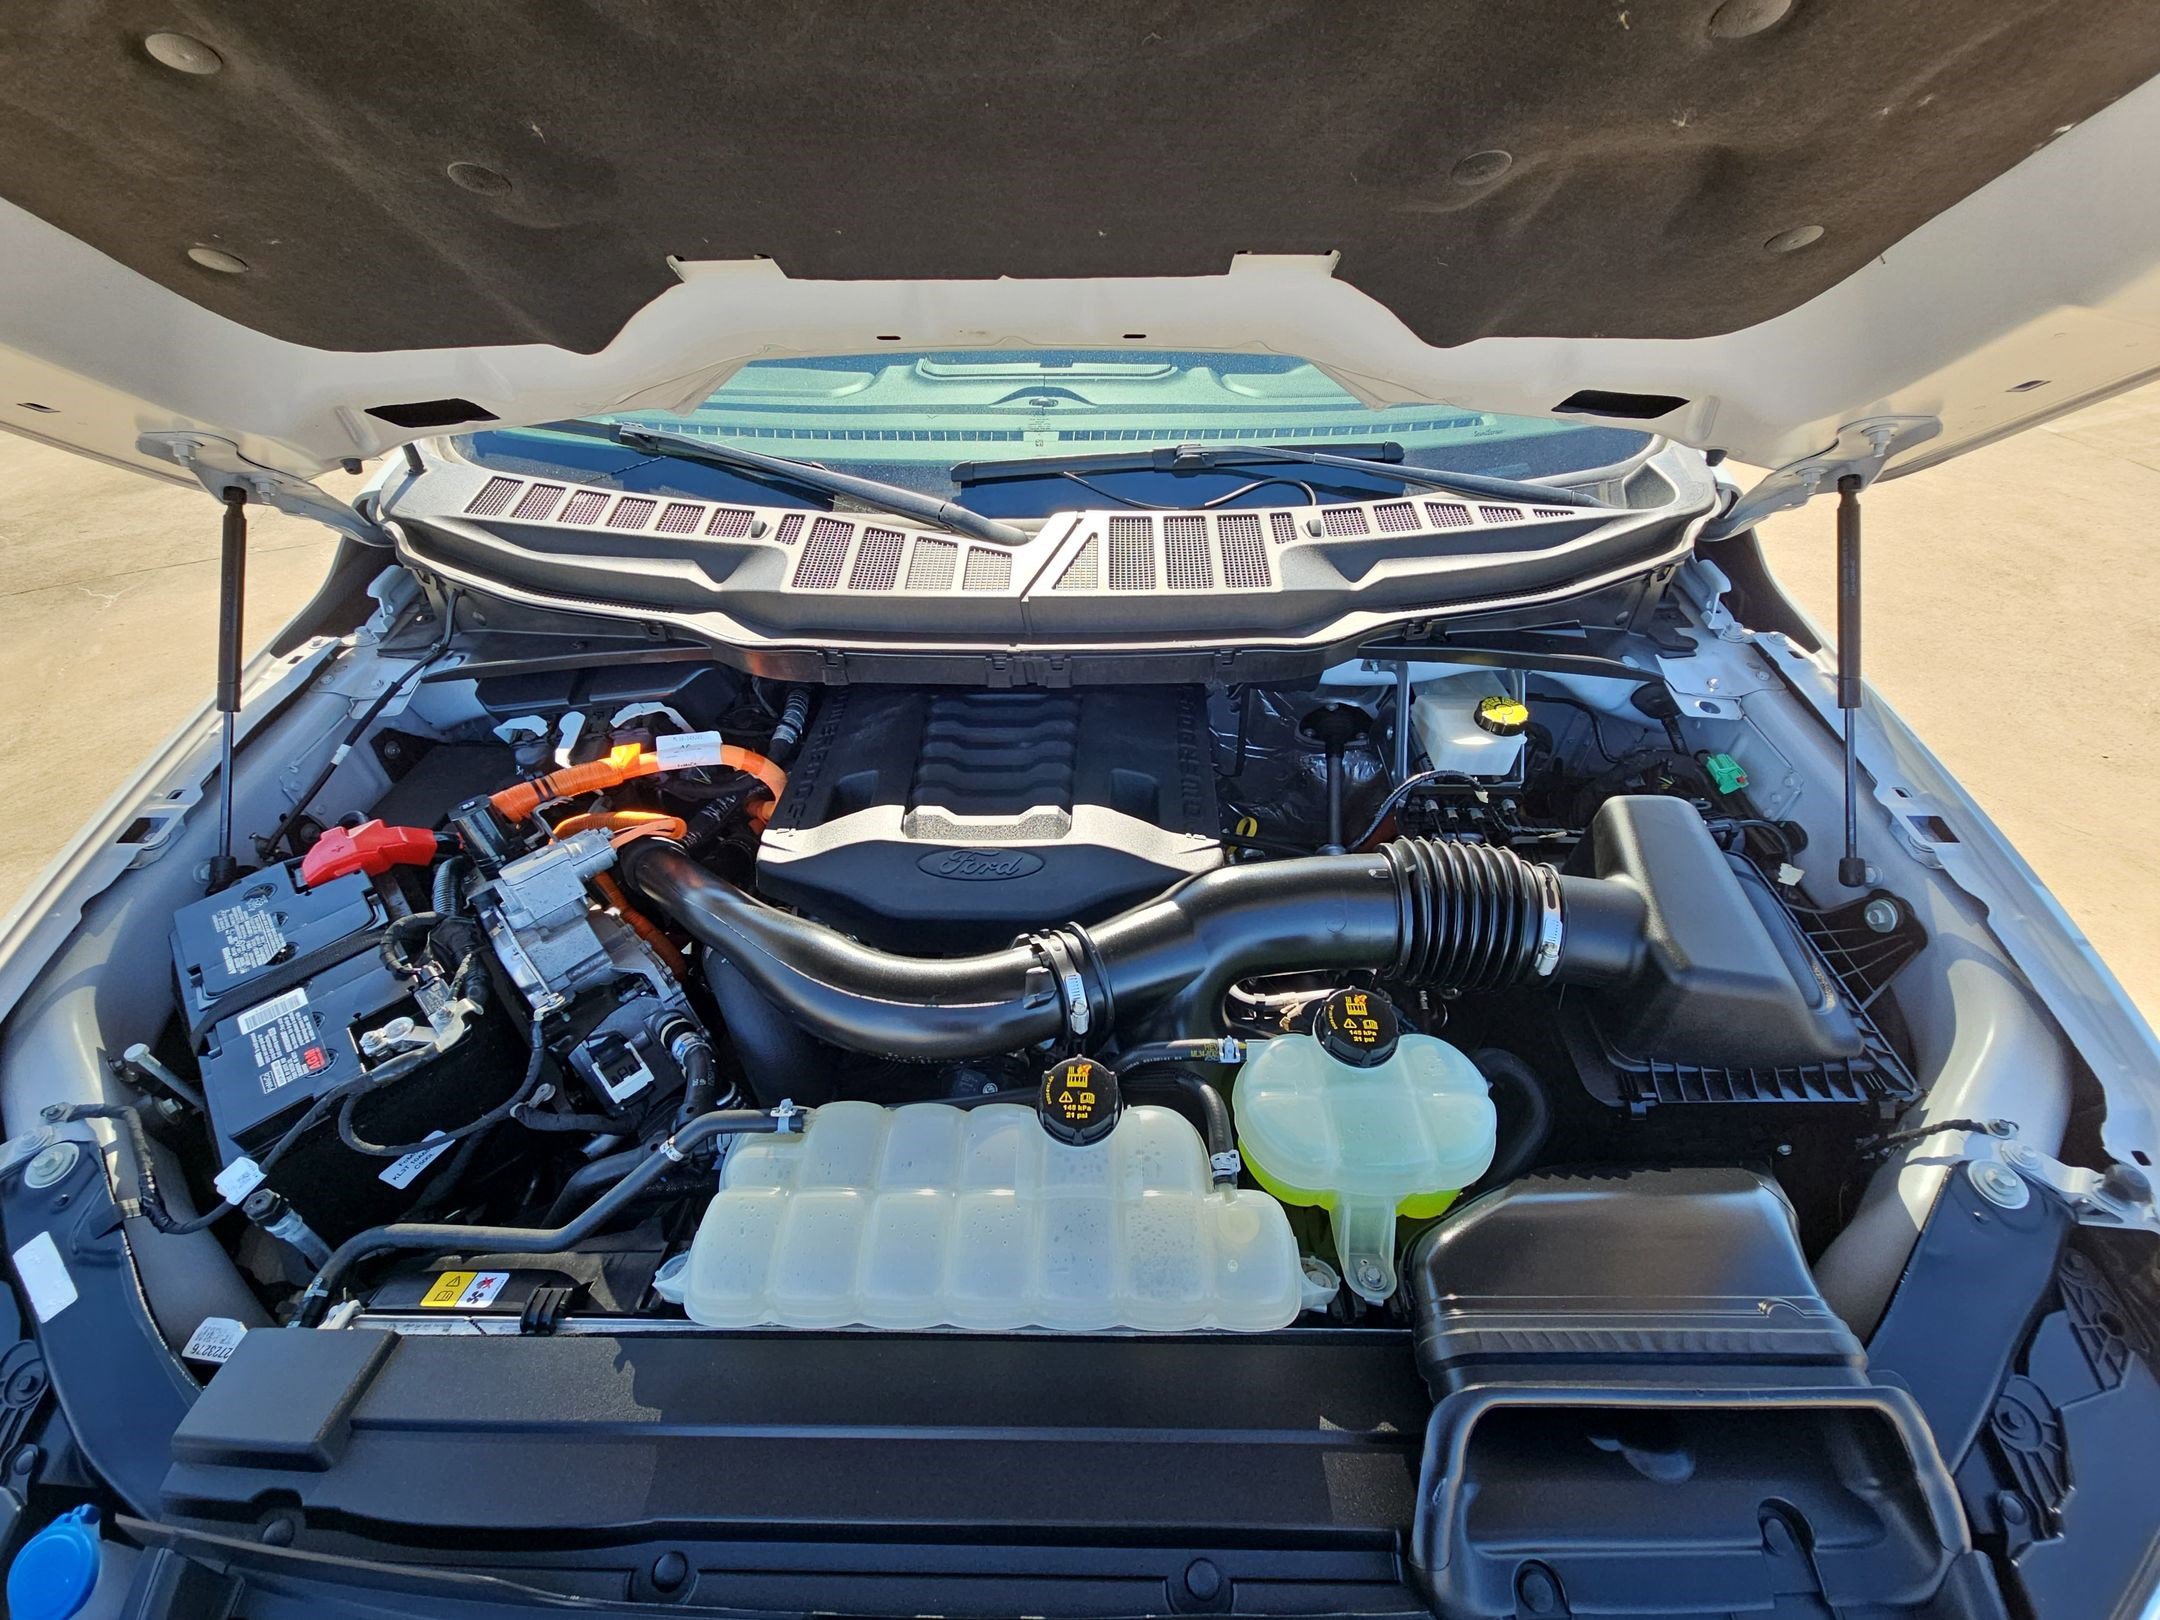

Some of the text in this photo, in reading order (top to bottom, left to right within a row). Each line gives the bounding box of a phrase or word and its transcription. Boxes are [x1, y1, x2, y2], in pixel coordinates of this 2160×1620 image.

[939, 850, 1024, 876] Ford
[1078, 1104, 1092, 1112] kPa
[1076, 1112, 1088, 1120] psi
[191, 1343, 233, 1359] 2723276
